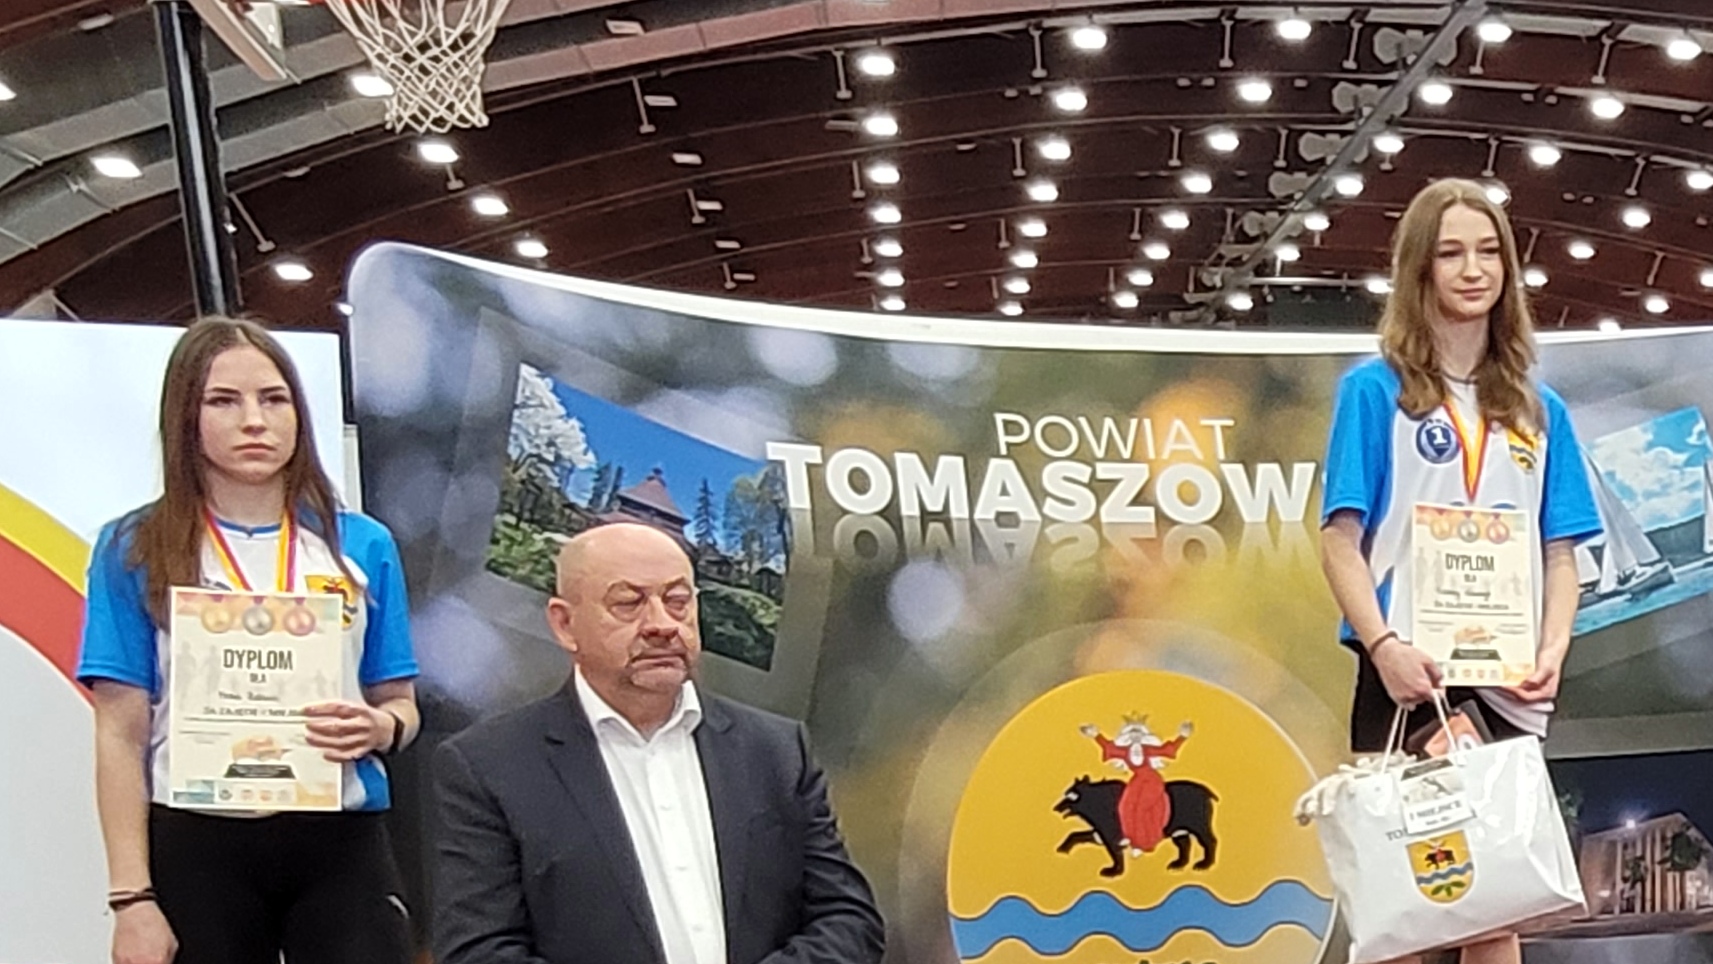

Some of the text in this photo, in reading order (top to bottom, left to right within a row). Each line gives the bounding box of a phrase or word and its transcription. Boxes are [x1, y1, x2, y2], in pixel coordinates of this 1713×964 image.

[995, 412, 1235, 459] POWIAT
[765, 441, 1327, 525] TOMASZOW
[1445, 553, 1495, 572] DYPLOM
[223, 649, 294, 670] DYPLOM
